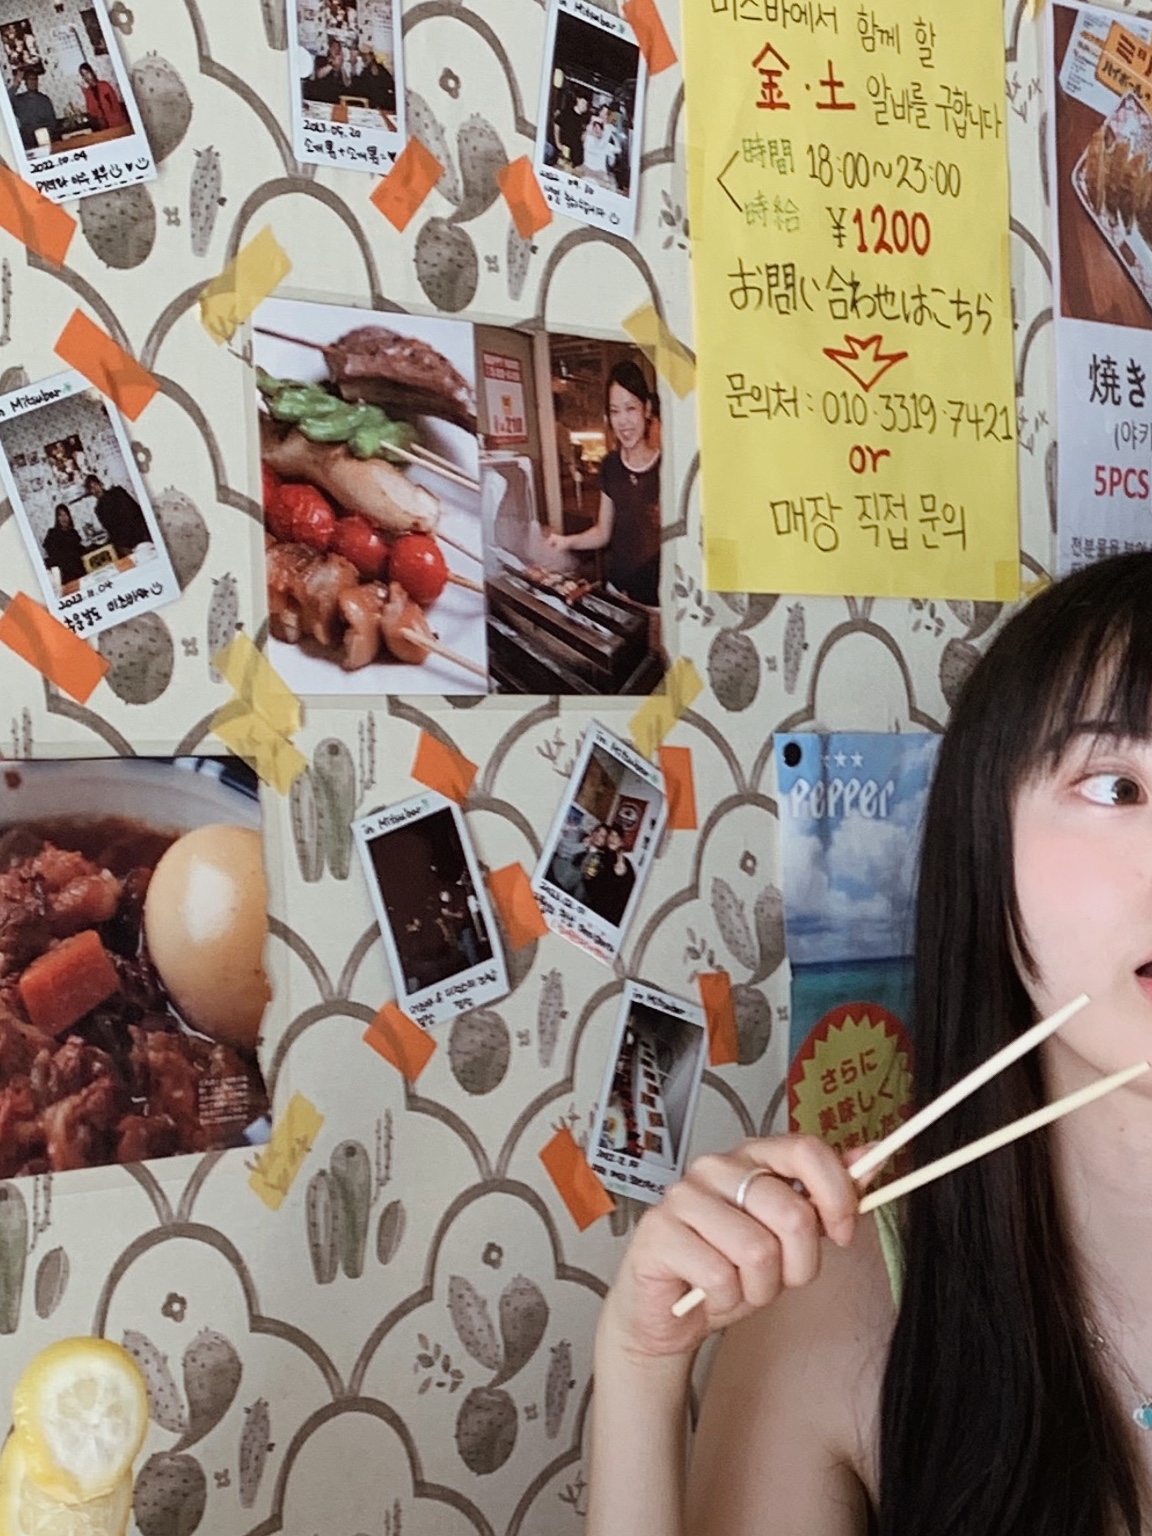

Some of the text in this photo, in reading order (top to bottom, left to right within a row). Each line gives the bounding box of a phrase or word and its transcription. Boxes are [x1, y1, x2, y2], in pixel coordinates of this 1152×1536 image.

[857, 3, 902, 54] 함께
[913, 15, 937, 69] 할
[866, 72, 1003, 139] 알바를 구합니다
[727, 256, 994, 337] お問い合わせはこちら
[10, 388, 62, 414] Mitsubar
[849, 445, 892, 475] or
[1094, 464, 1150, 501] 5PCS
[769, 492, 967, 553] 매장 직접 문의
[820, 1048, 878, 1094] さらに
[818, 1074, 894, 1137] 美味しく
